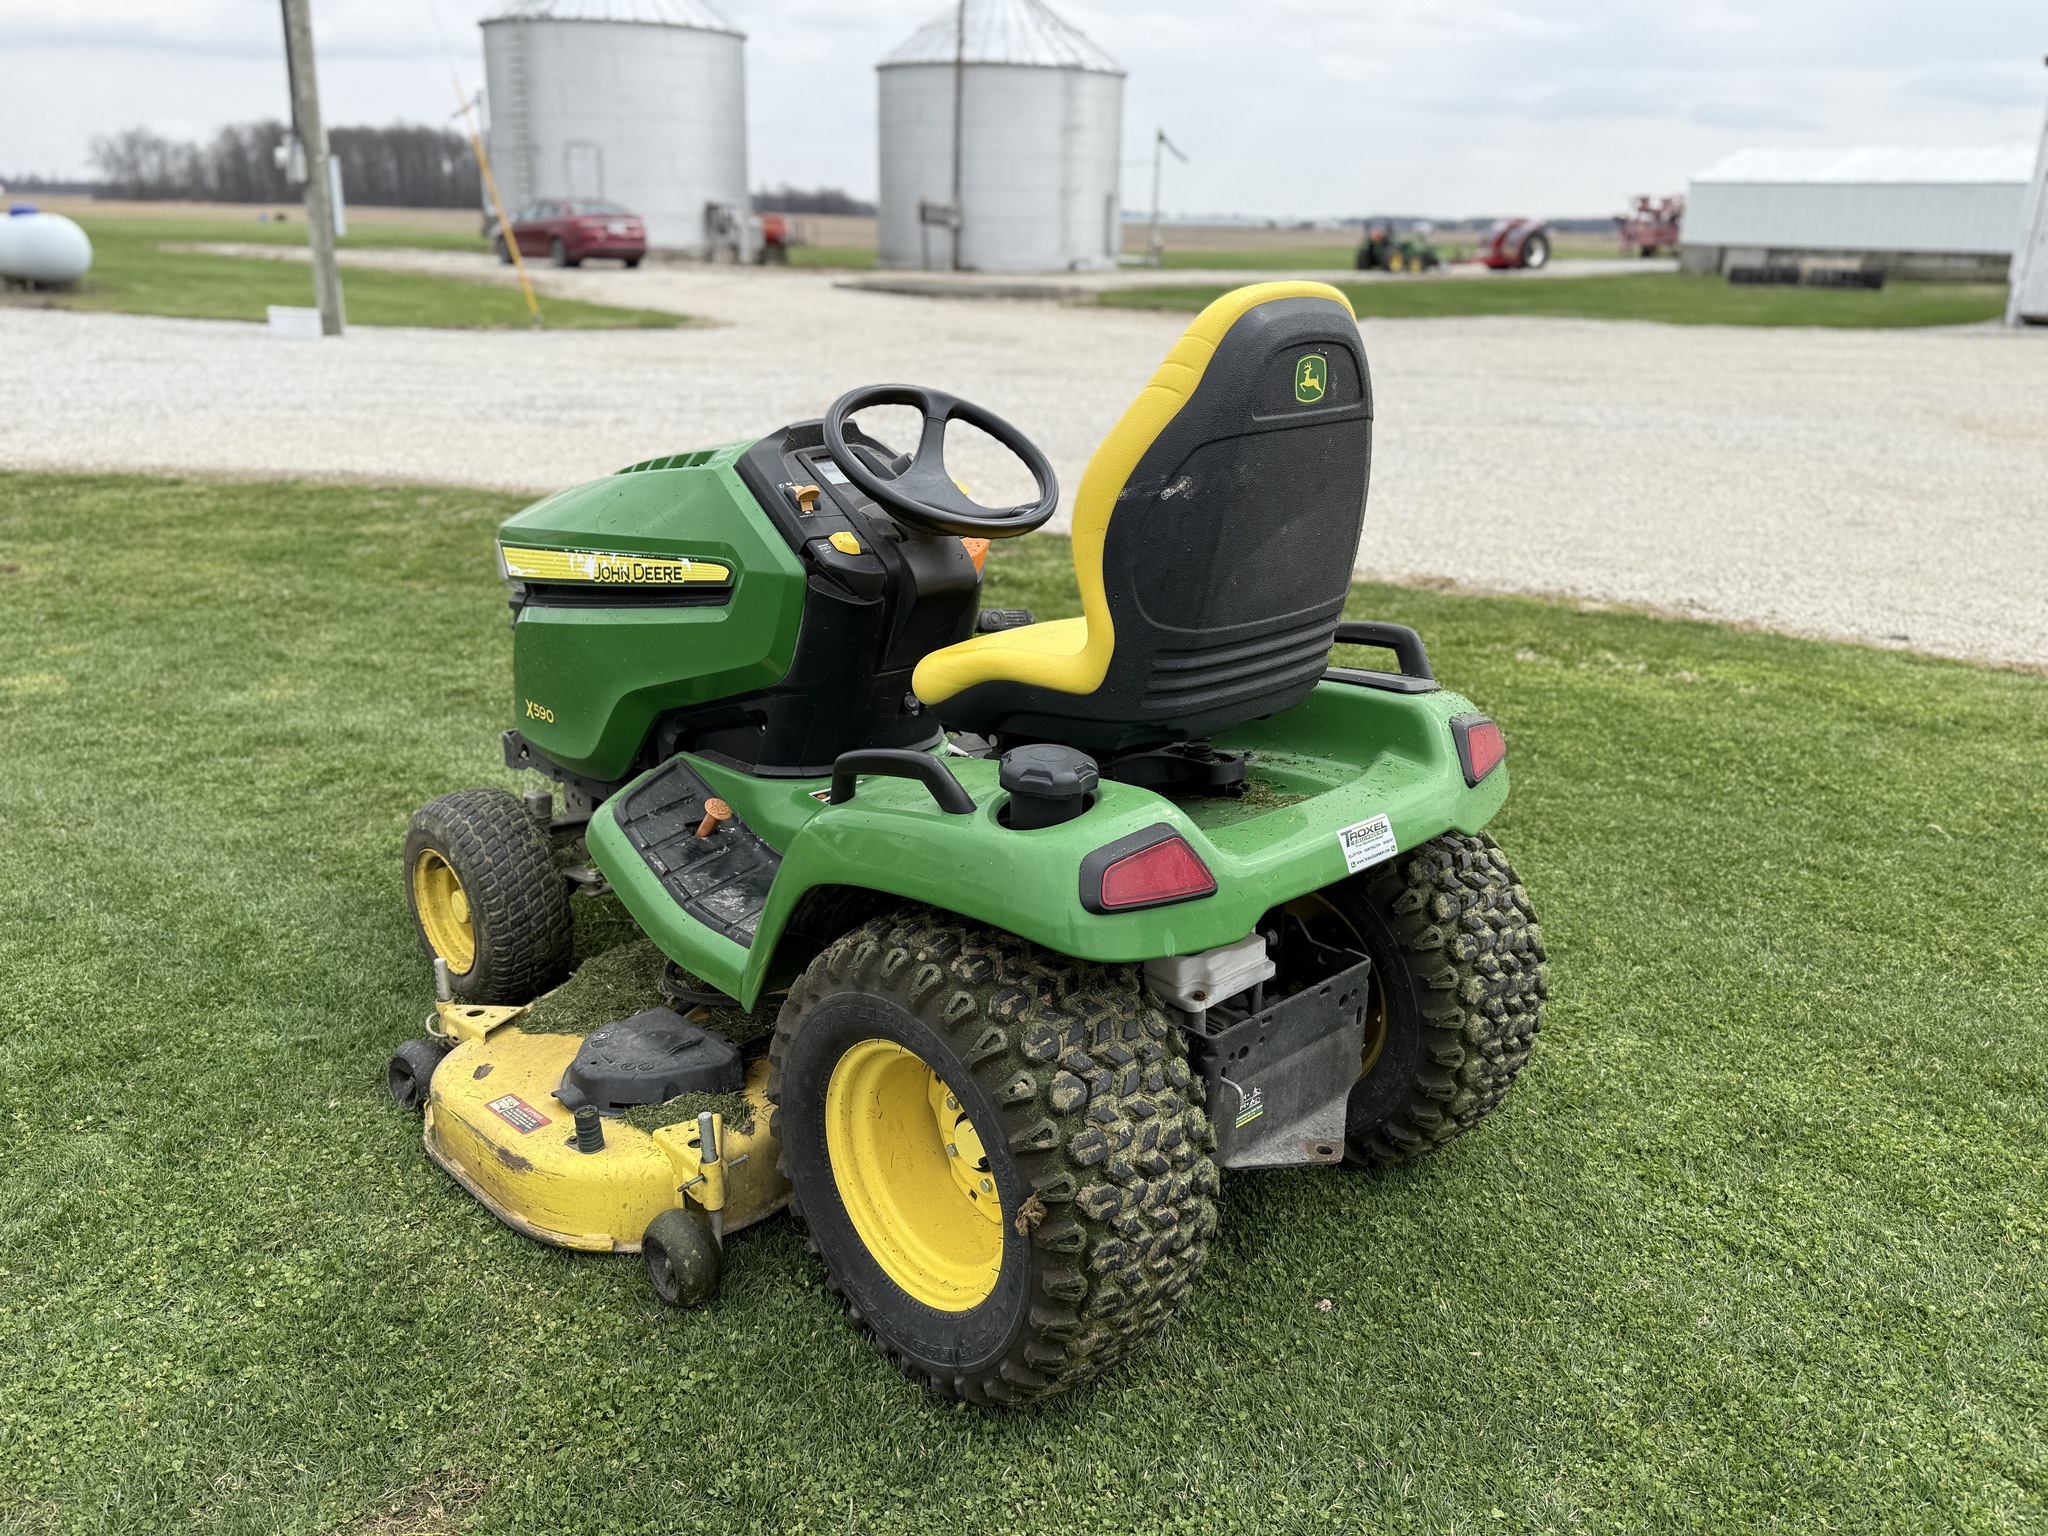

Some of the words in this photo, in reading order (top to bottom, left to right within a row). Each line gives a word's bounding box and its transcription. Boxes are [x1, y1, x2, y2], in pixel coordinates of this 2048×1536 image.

[594, 563, 630, 581] JOHN
[633, 563, 683, 581] DEERE
[525, 699, 554, 723] X590
[1341, 821, 1388, 848] TROXEL
